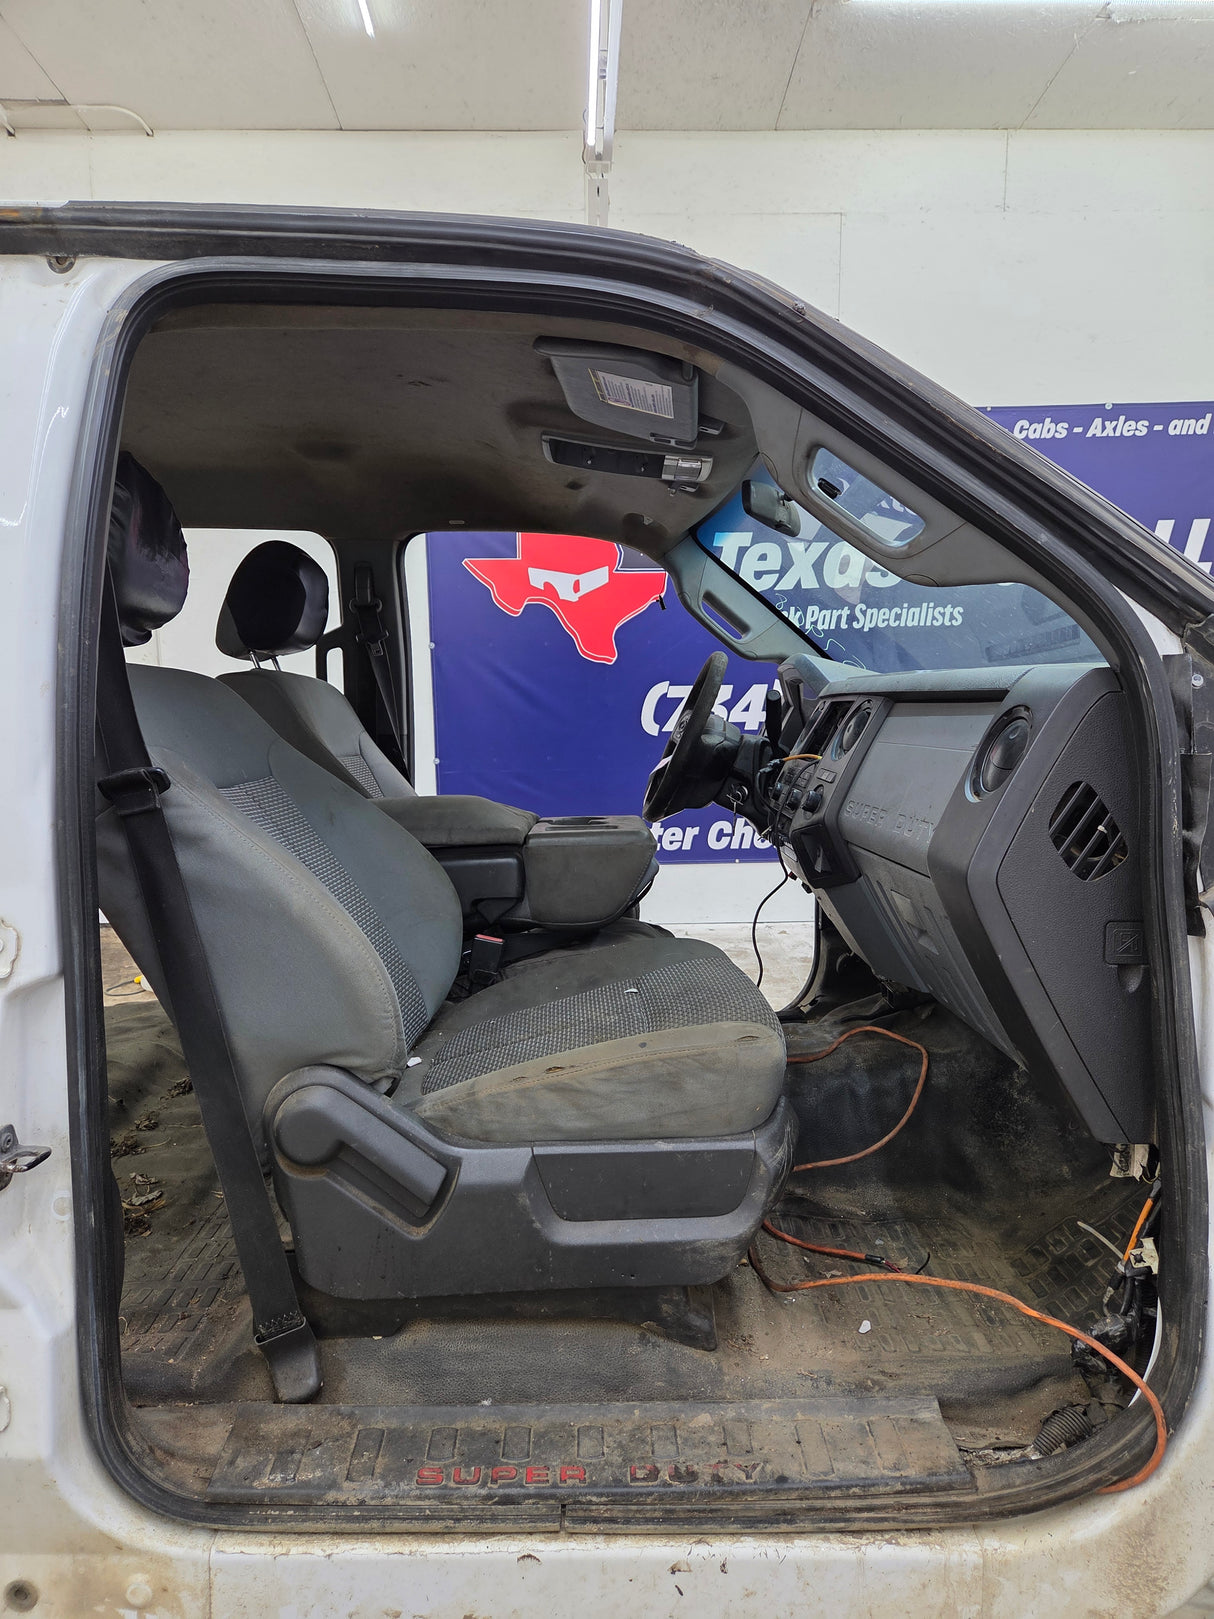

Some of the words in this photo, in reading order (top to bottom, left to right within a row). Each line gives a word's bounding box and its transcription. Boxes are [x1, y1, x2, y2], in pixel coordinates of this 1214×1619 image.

[1013, 418, 1069, 440] Cabs
[1086, 416, 1149, 437] Axles
[1168, 413, 1212, 436] and
[805, 605, 850, 630] Part
[853, 603, 964, 632] Specialists
[416, 1466, 587, 1486] SUPER
